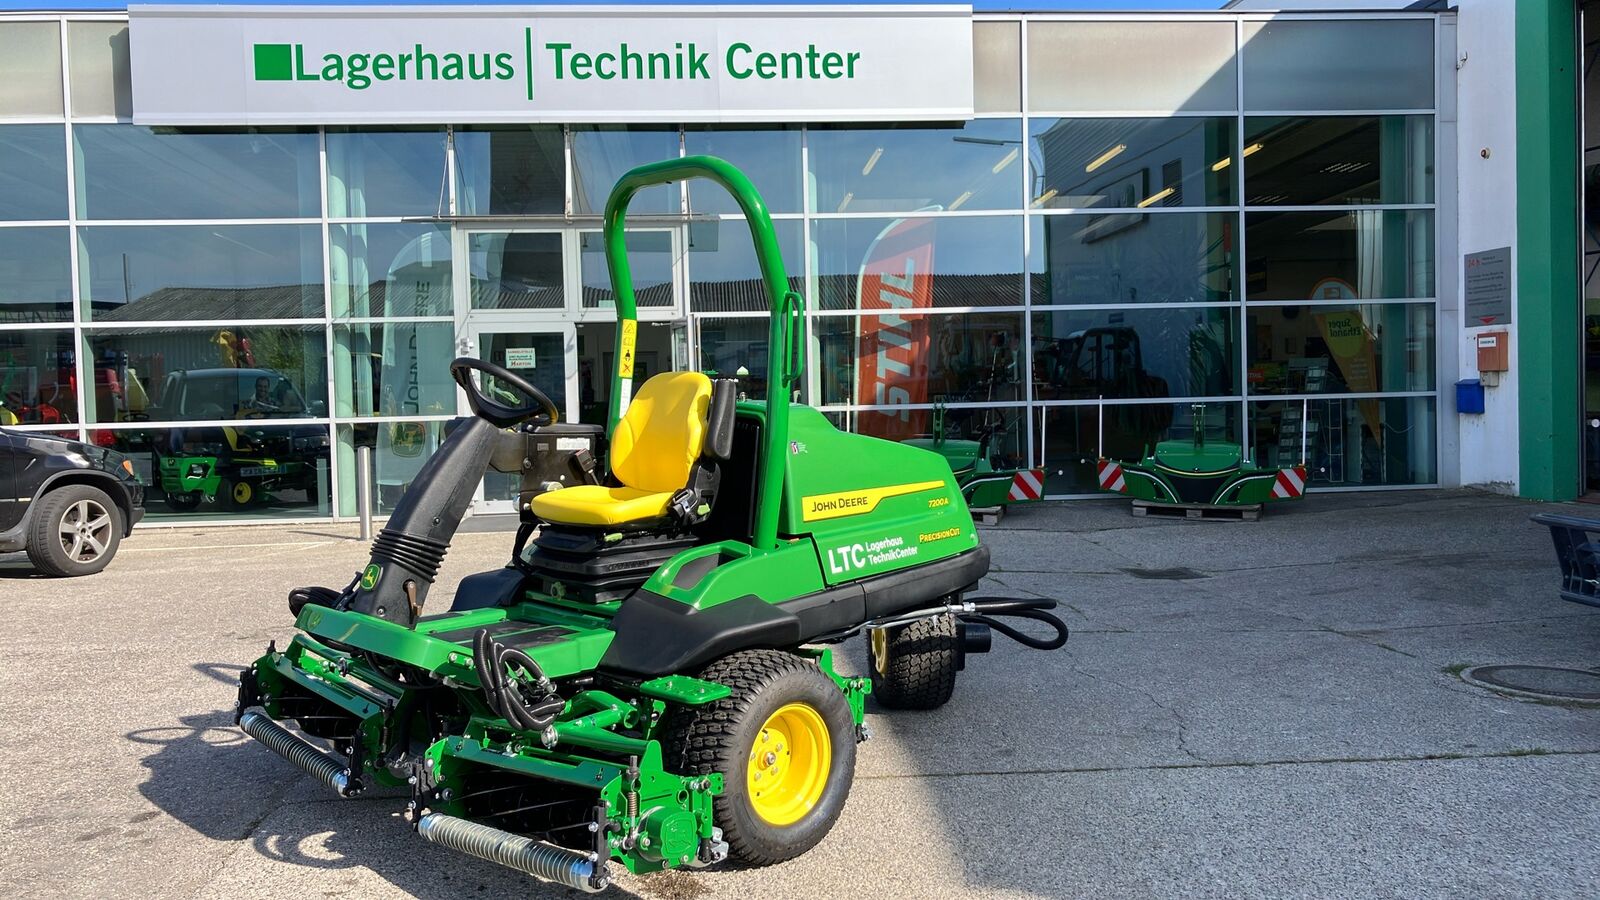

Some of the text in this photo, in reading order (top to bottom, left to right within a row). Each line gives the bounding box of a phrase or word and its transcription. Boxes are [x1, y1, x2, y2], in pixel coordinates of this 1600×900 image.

[295, 44, 514, 90] Lagerhaus
[545, 42, 860, 79] Technik Center
[876, 257, 914, 422] STIHL
[812, 496, 868, 512] JOHN DEERE
[928, 497, 949, 508] 7200A
[865, 537, 903, 552] Lagerhaus
[867, 546, 918, 565] TechnikCenter
[828, 544, 866, 574] LTC
